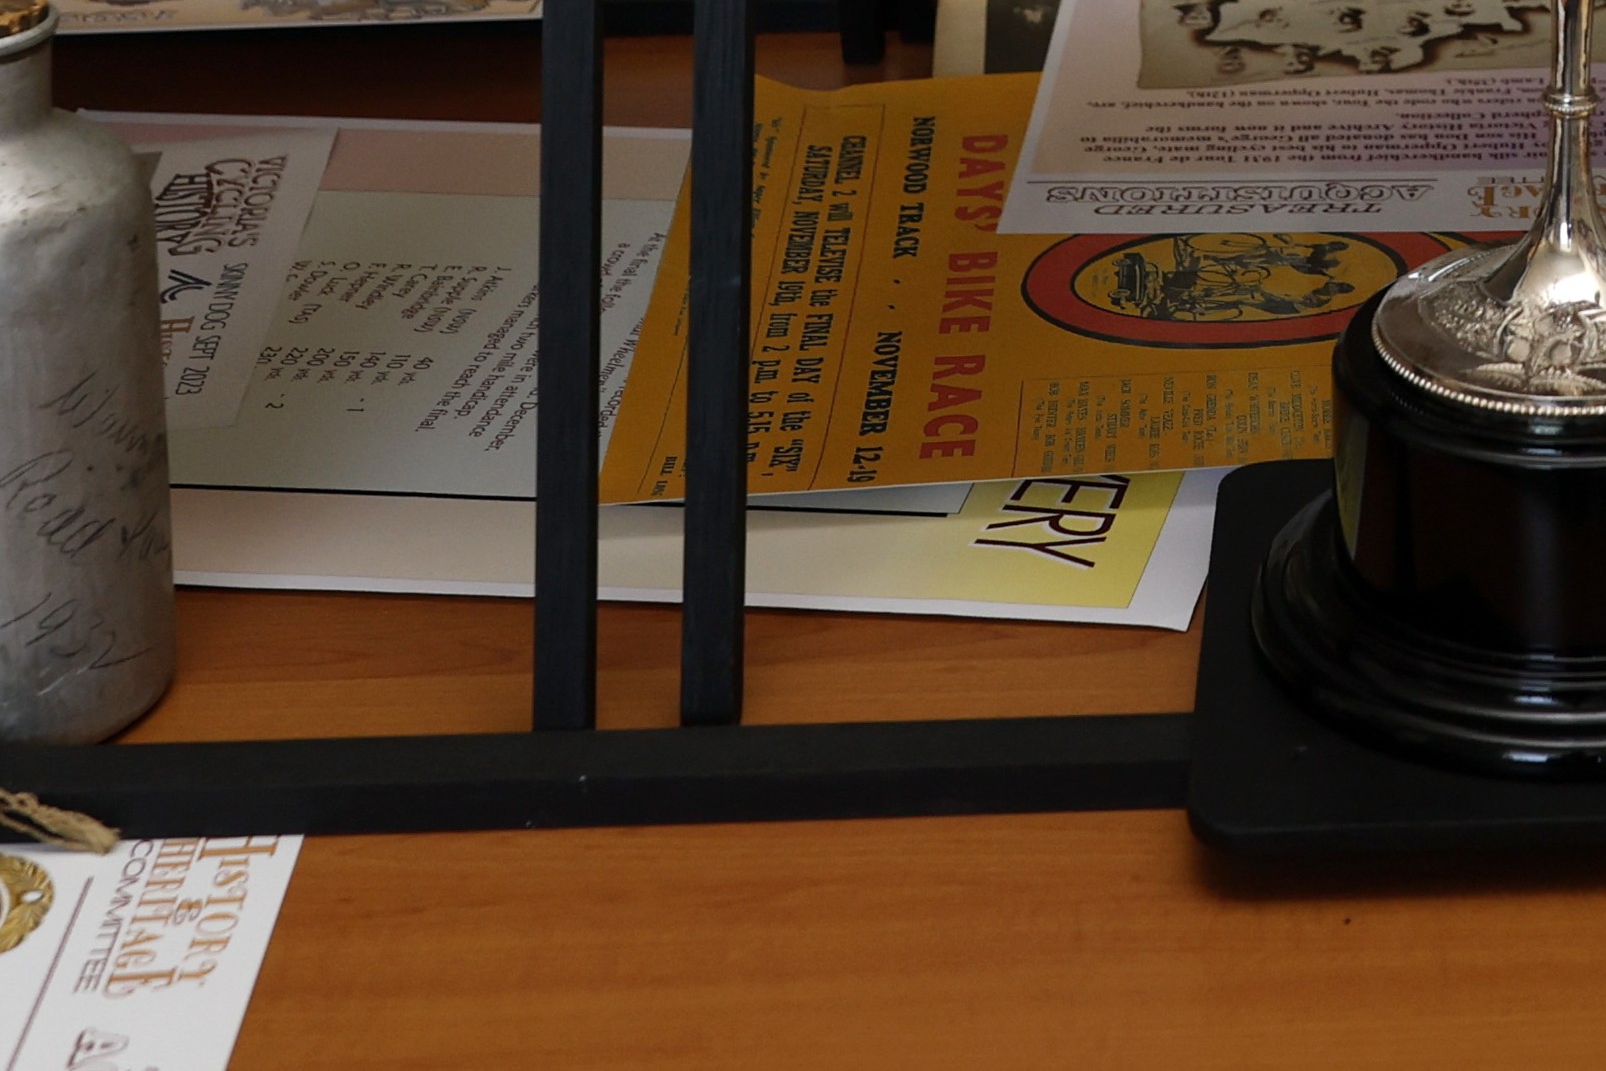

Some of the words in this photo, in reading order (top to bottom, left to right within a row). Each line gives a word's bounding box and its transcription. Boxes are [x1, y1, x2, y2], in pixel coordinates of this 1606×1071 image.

[834, 135, 868, 184] CHANNEL
[904, 116, 936, 195] NORWOOD
[827, 201, 854, 222] will
[1047, 183, 1435, 205] ACQUISITIONS
[1094, 201, 1385, 218] TREASURED
[892, 201, 924, 259] TRACK
[814, 227, 851, 284] TELEVISE
[809, 289, 838, 308] the
[938, 251, 999, 335] BIKE
[799, 313, 834, 351] FINAL
[791, 357, 824, 385] DAY
[859, 331, 903, 437] NOVEMBER
[787, 391, 815, 405] of
[919, 353, 987, 460] RACE
[780, 410, 812, 432] the
